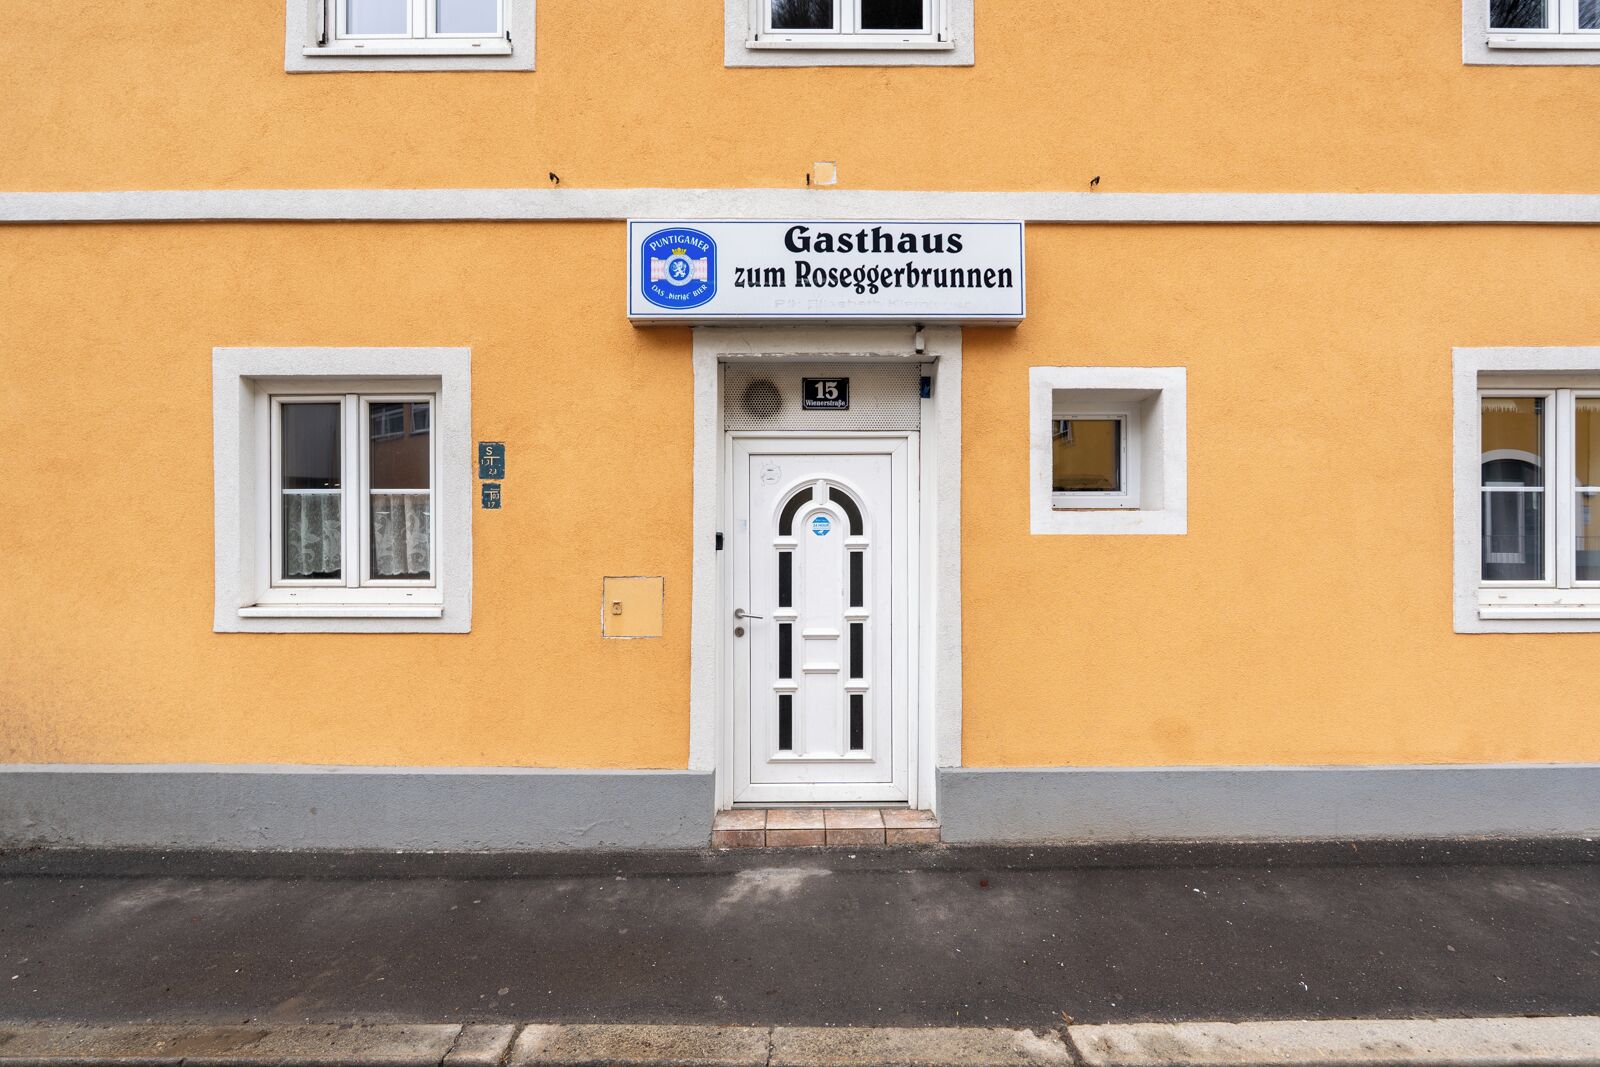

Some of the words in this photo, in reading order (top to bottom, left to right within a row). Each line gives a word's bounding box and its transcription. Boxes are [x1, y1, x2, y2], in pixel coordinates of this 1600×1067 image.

[649, 235, 710, 252] PUNTIGAMER
[784, 225, 964, 254] Gasthaus
[734, 265, 786, 288] zum
[795, 260, 1014, 295] Roseggerbrunnen
[651, 284, 665, 297] DAS
[692, 284, 708, 297] BIER
[814, 381, 839, 400] 15
[805, 399, 846, 408] Wienerstraße
[485, 446, 493, 456] S
